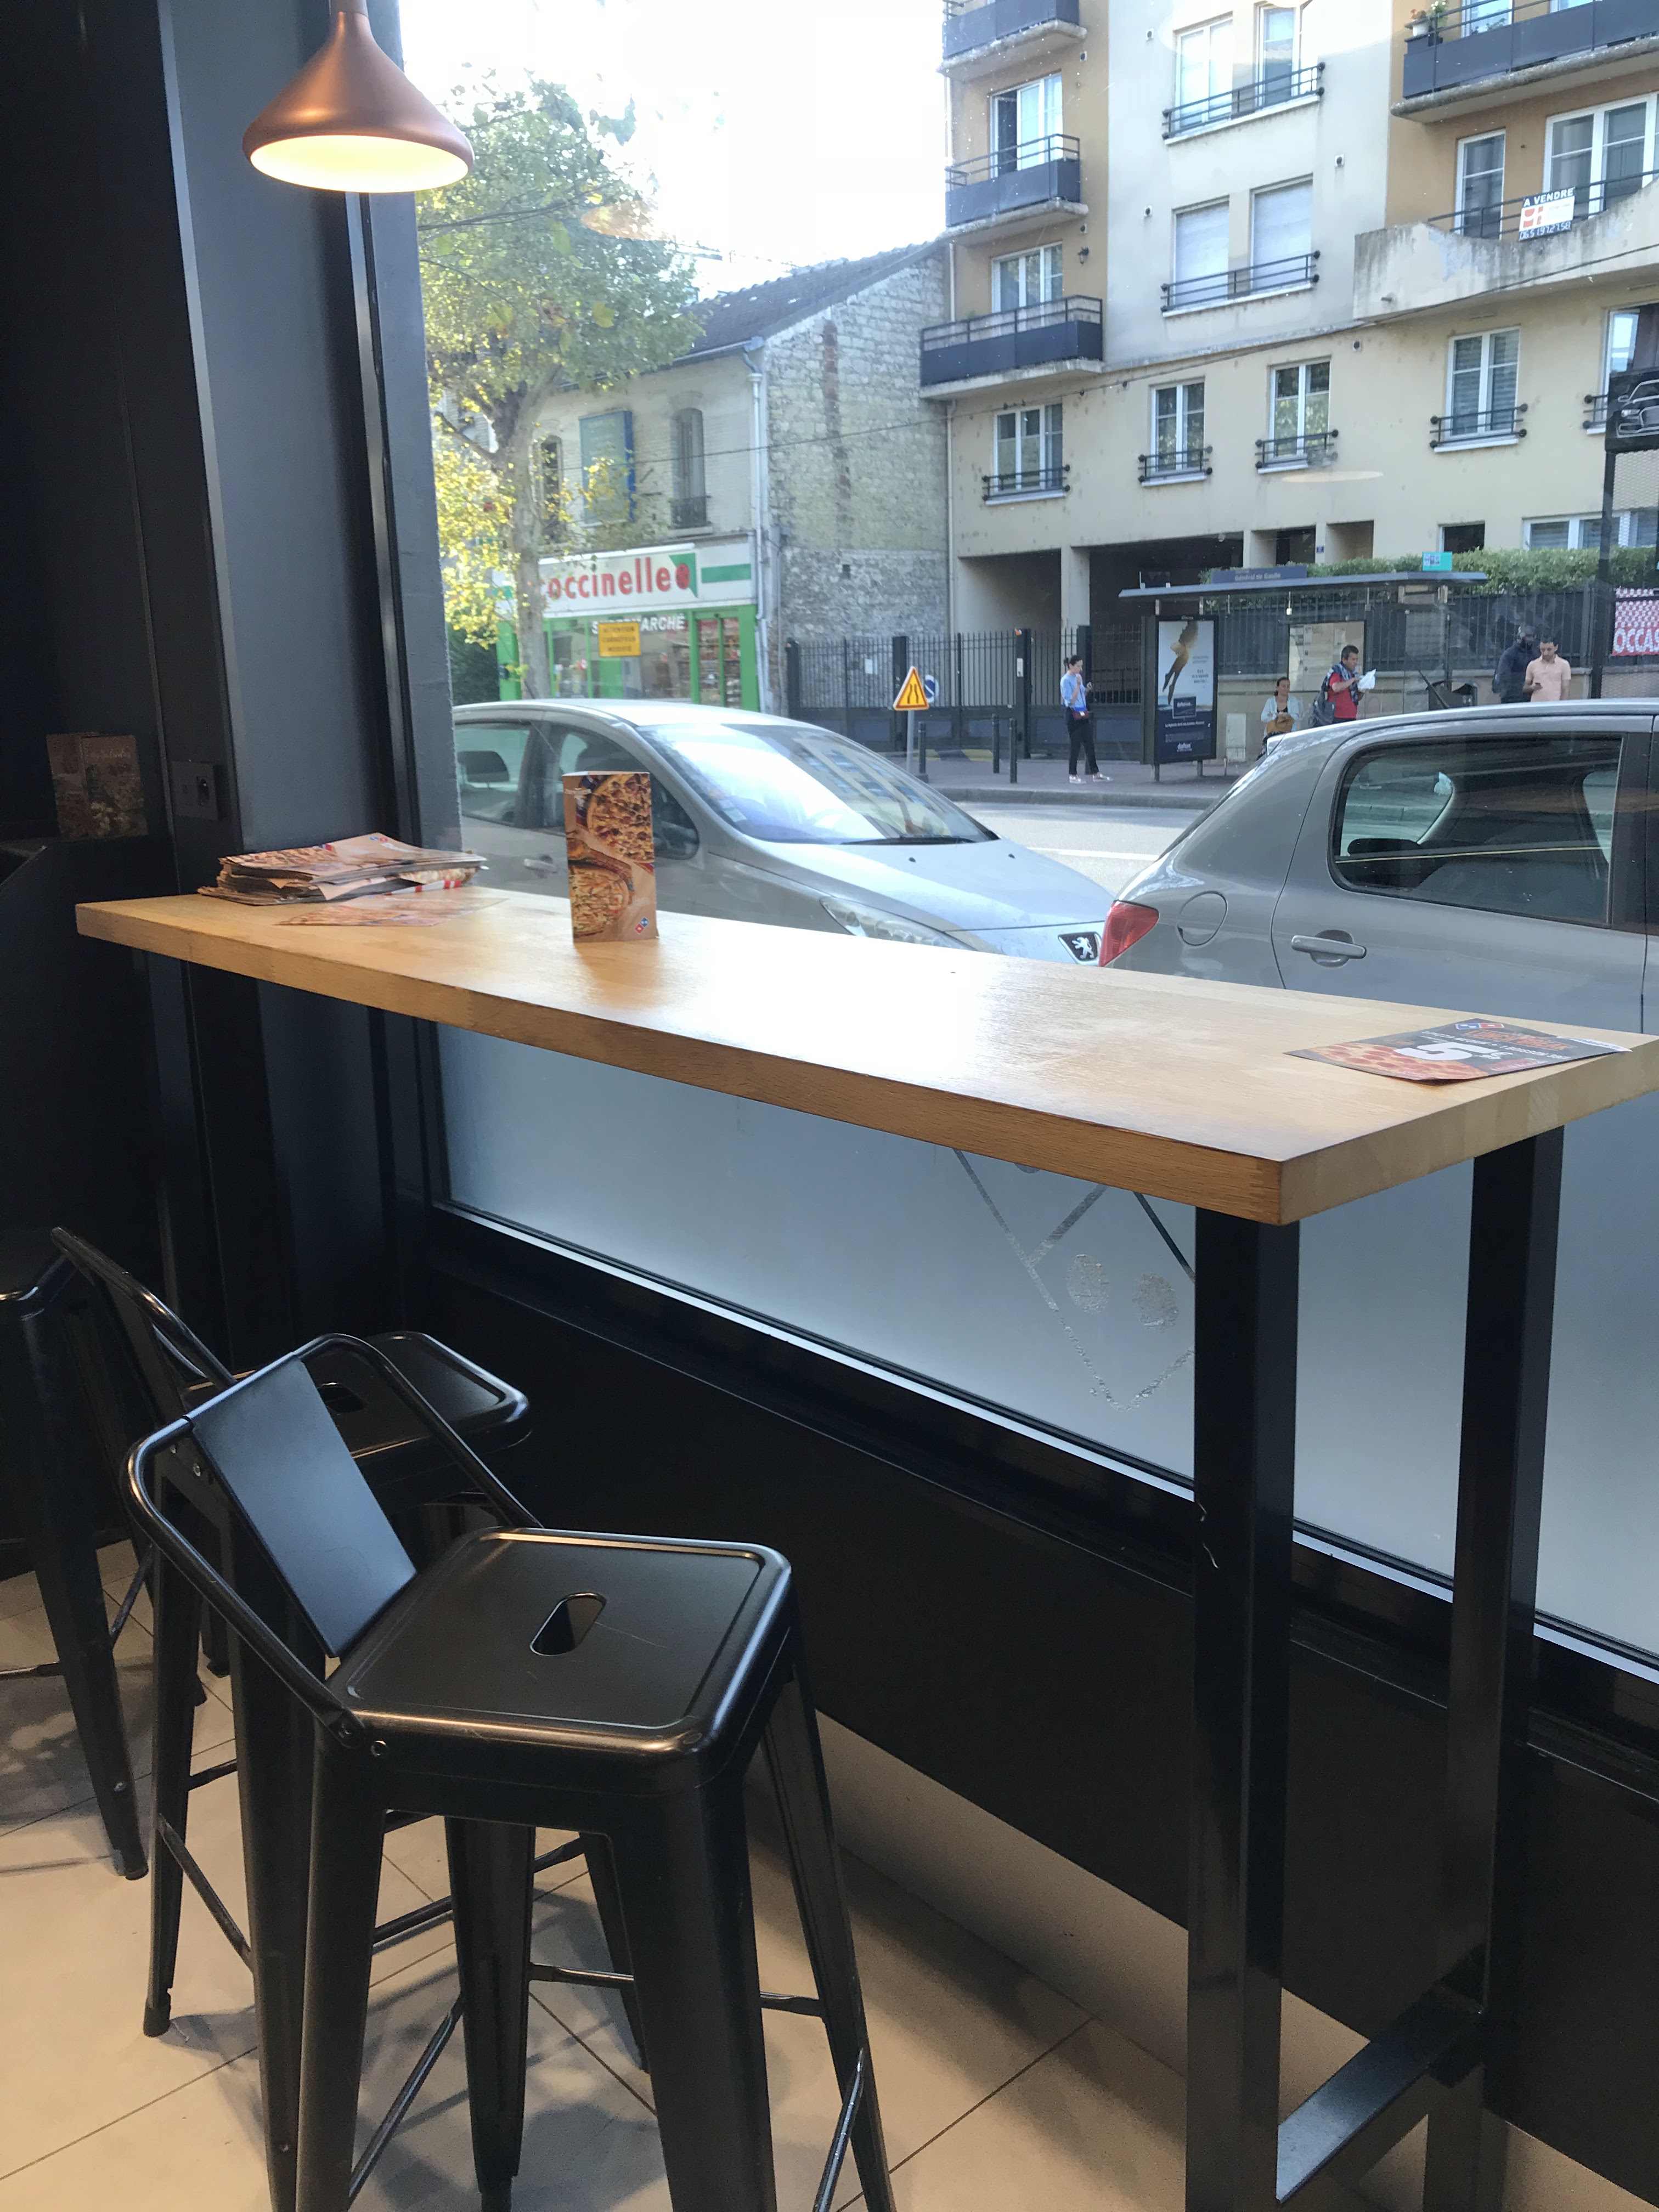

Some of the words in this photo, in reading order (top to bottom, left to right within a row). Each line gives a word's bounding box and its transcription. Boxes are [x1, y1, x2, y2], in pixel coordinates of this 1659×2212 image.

[1523, 198, 1530, 207] A
[1534, 188, 1574, 205] VENDRE
[540, 557, 671, 600] occinelle
[591, 613, 685, 634] SARCHÉ
[1394, 1042, 1498, 1060] 5
